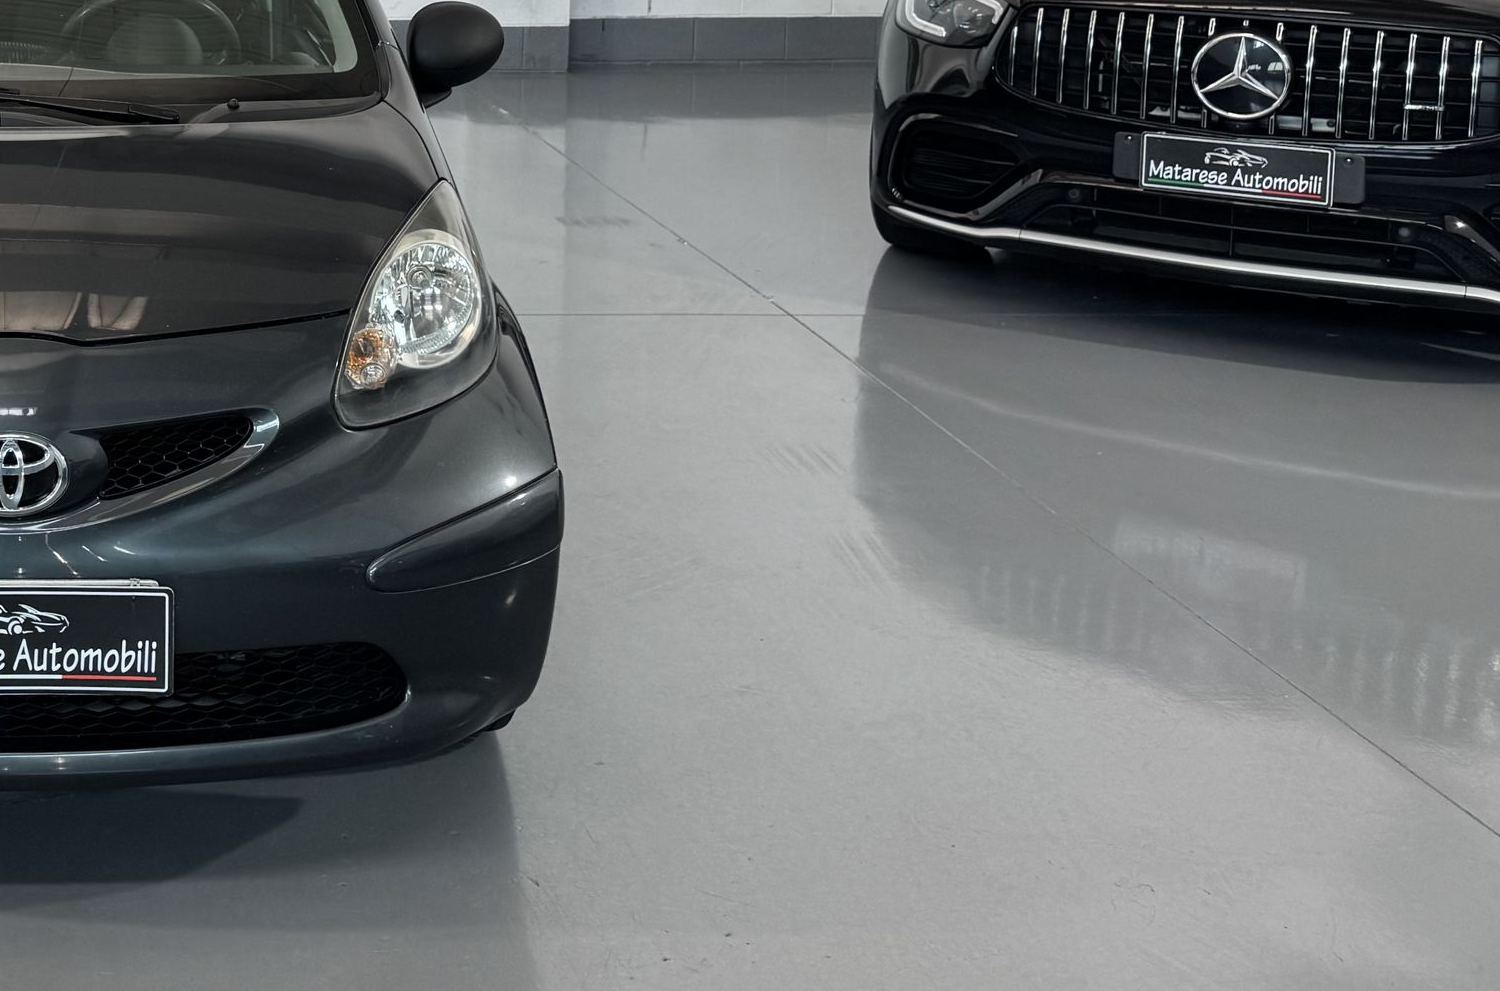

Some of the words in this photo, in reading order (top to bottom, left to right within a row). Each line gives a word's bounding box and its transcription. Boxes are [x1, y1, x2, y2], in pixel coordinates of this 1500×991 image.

[1148, 159, 1228, 185] Matarese
[1231, 168, 1323, 195] Automobili
[12, 637, 158, 675] Automobili
